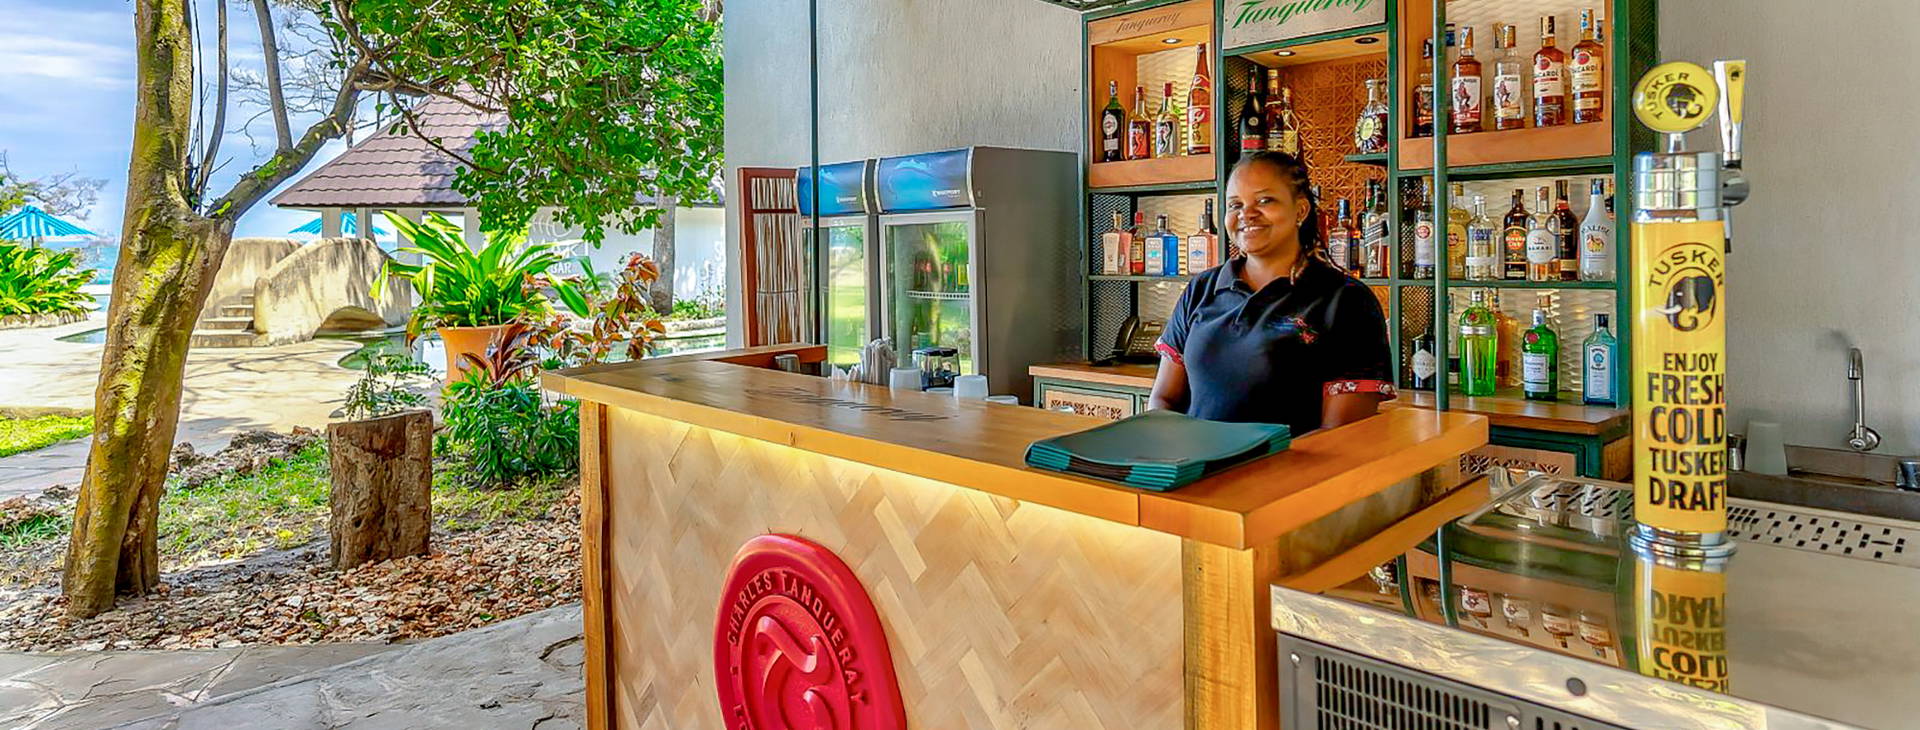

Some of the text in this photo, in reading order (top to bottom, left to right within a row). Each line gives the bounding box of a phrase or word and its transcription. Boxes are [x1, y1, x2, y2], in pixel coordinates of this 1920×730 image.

[1646, 72, 1690, 120] TUSKER
[1648, 249, 1724, 288] TUSKER
[1663, 352, 1718, 372] ENJOY
[1648, 372, 1725, 405] FRESH
[1649, 405, 1725, 445] COLD
[1649, 476, 1727, 511] DRAFT
[727, 570, 869, 704] CHARLES TANQUERAY
